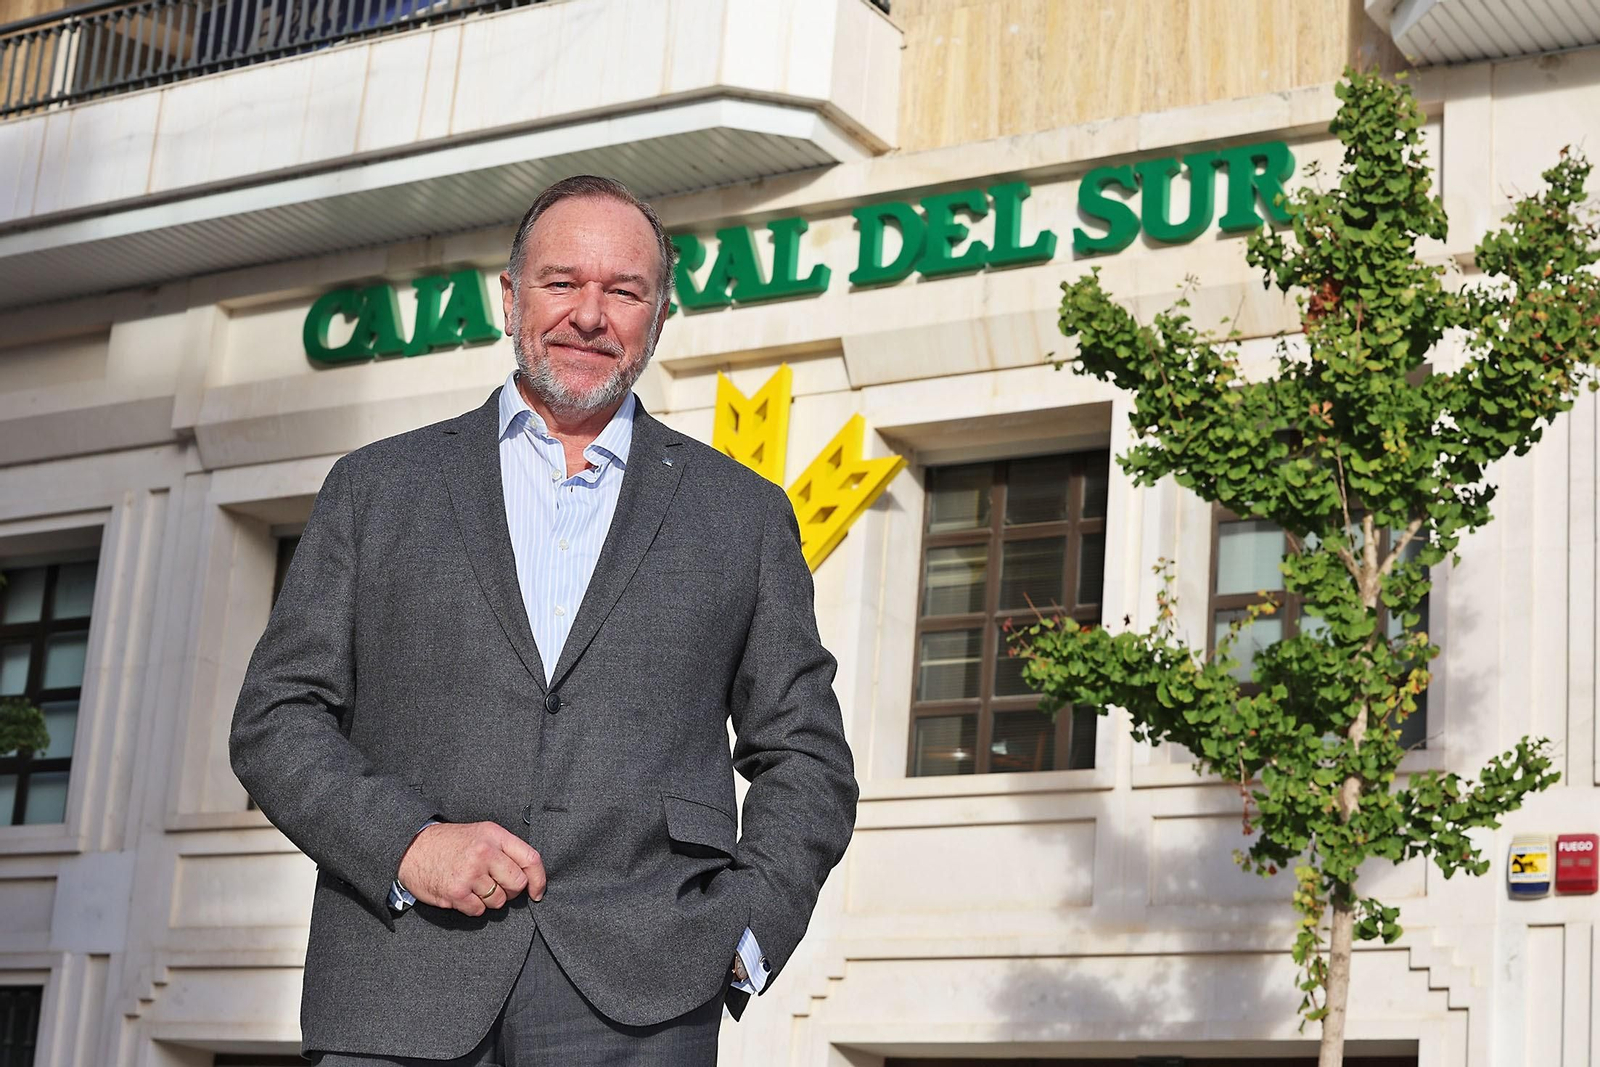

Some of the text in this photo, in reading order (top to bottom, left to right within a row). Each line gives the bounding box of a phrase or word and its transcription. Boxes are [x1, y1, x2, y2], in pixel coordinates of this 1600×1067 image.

[303, 140, 1296, 363] CAJA RAL DEL SUR
[1558, 840, 1594, 852] FUEGO
